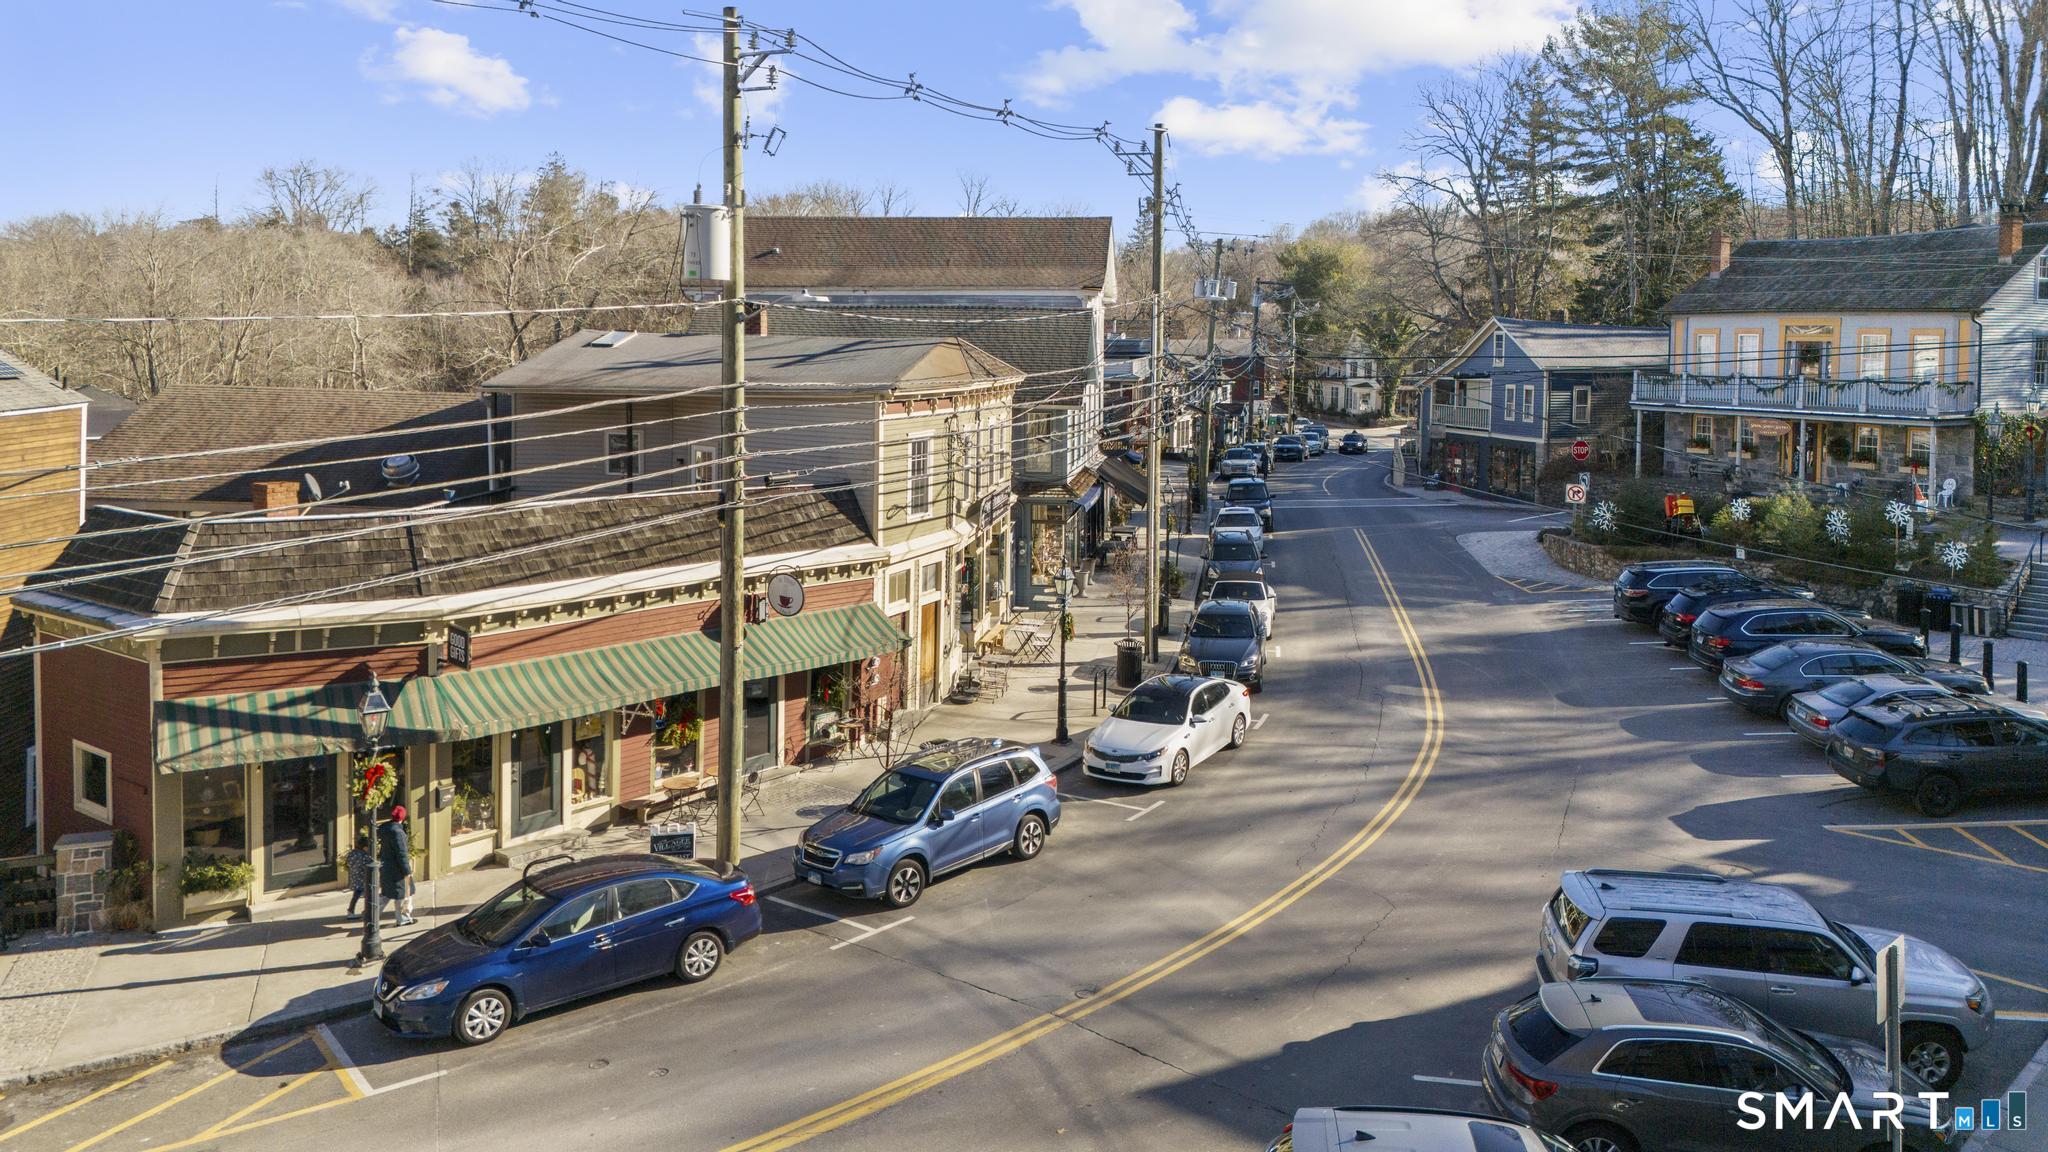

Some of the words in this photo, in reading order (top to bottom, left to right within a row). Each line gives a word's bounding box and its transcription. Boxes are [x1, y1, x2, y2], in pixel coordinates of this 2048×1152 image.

[1573, 446, 1588, 455] STOP
[450, 632, 465, 648] GOOD
[450, 646, 465, 663] GIFTS
